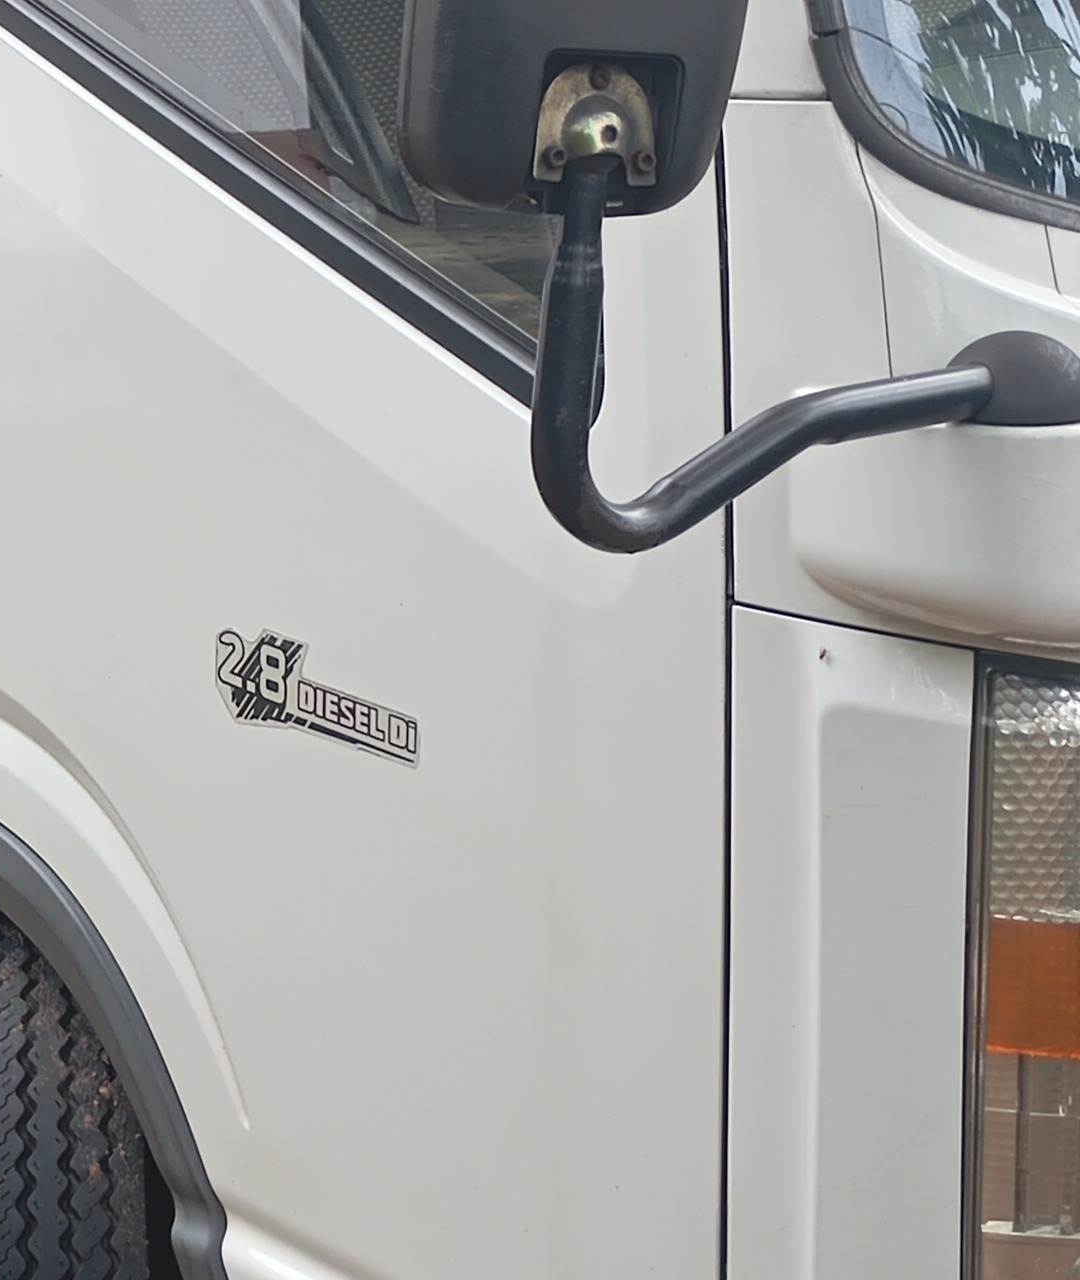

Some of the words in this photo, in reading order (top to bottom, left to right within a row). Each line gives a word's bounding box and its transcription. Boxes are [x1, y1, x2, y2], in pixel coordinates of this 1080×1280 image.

[218, 630, 287, 704] 2.8
[298, 680, 385, 741] DIESEL
[388, 714, 417, 754] Di
